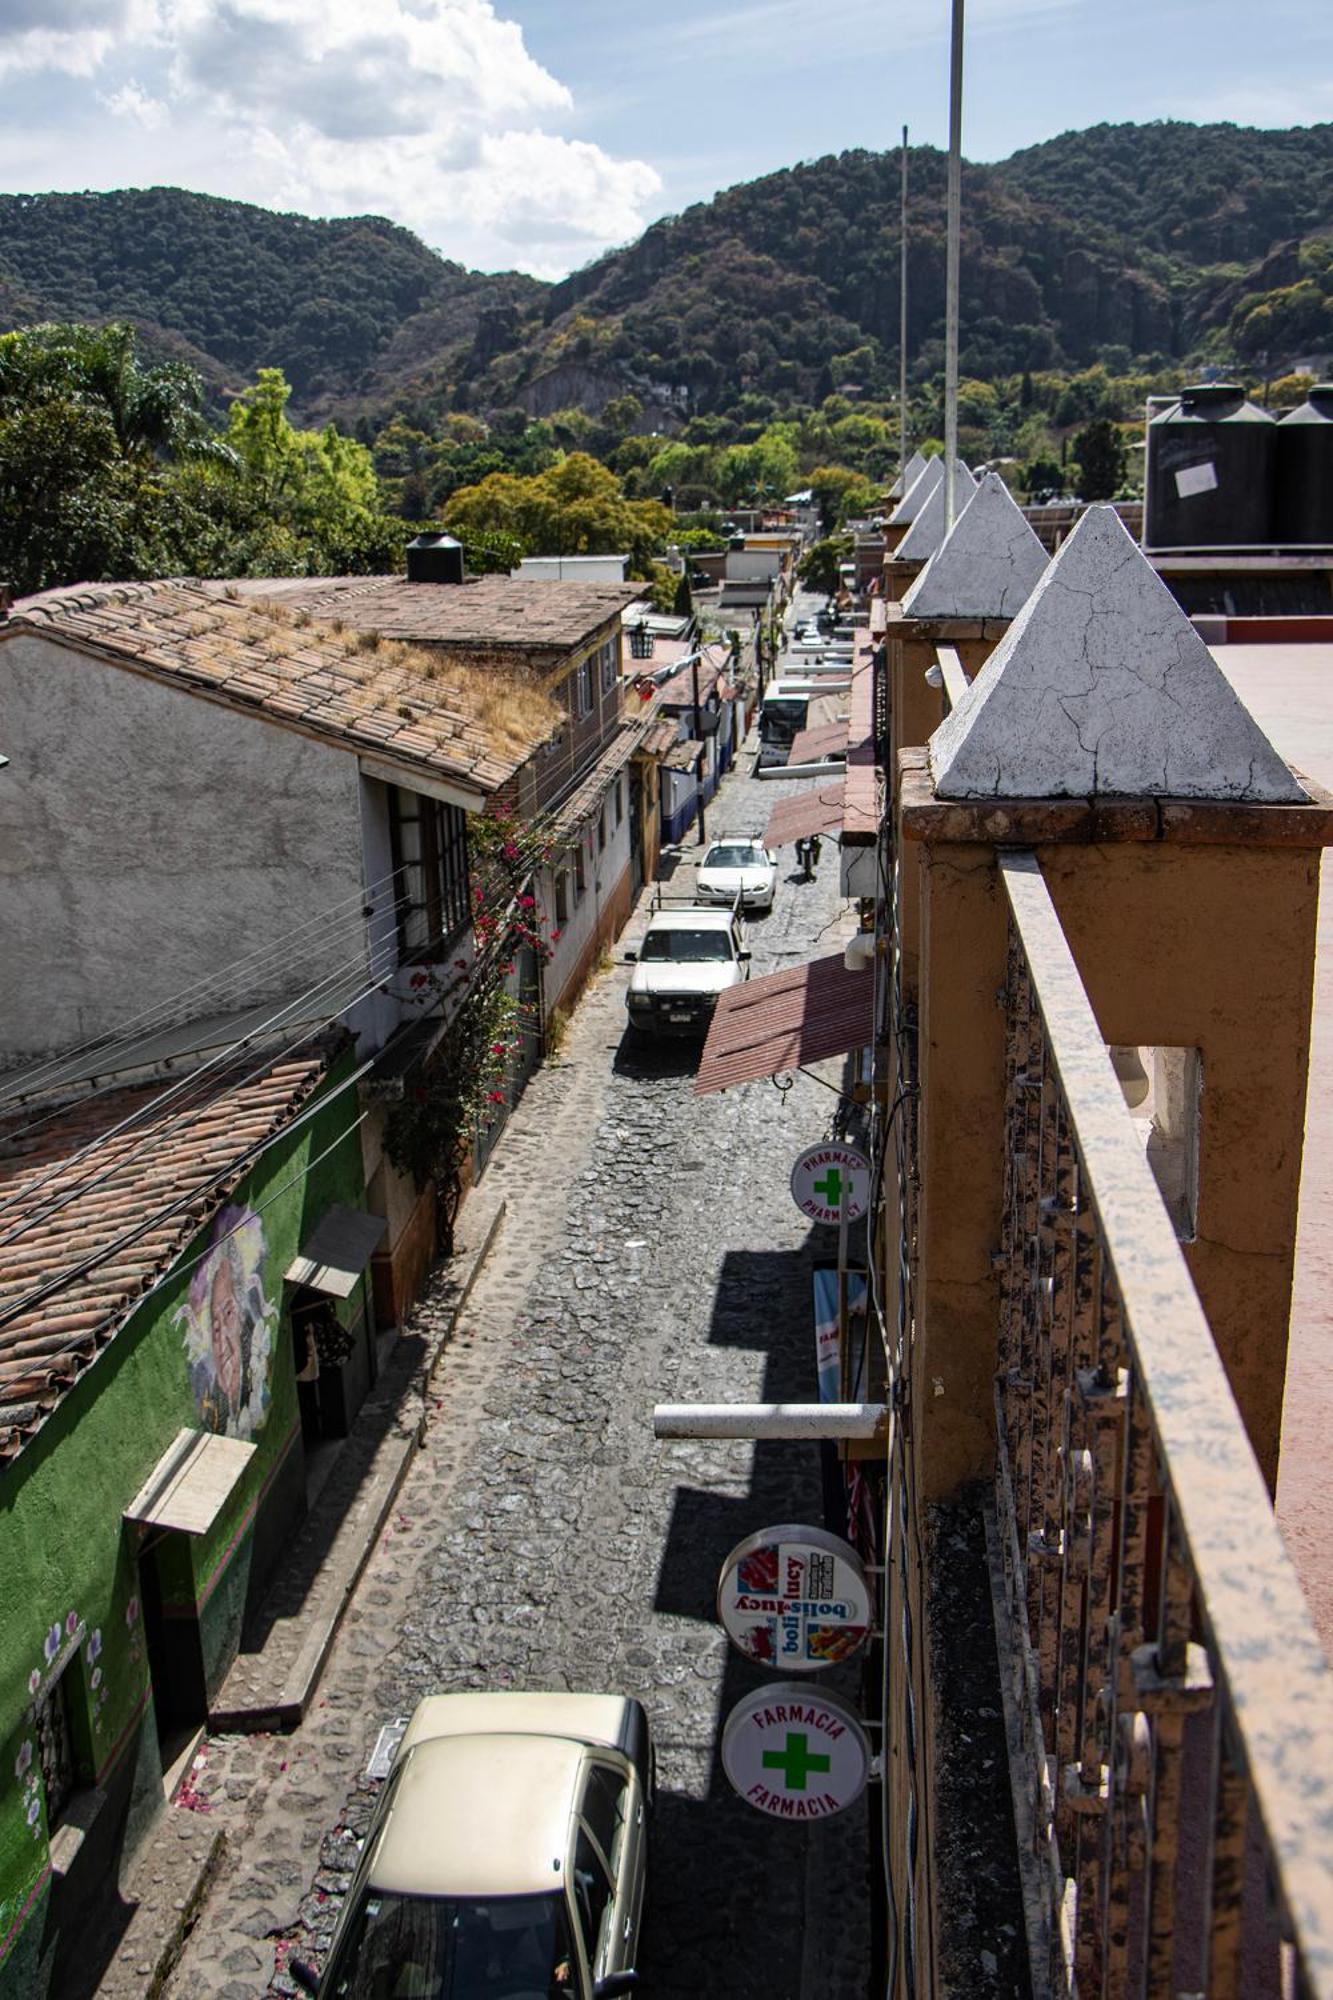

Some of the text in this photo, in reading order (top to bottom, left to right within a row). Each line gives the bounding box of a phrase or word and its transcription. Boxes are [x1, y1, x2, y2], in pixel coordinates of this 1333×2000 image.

[803, 1152, 863, 1172] PHARMACY
[802, 1200, 860, 1221] PHARMCY
[784, 1557, 804, 1599] lucy
[736, 1596, 847, 1618] bolis lucy
[752, 1705, 846, 1740] FARMACIA
[747, 1784, 840, 1816] FARMACIA
